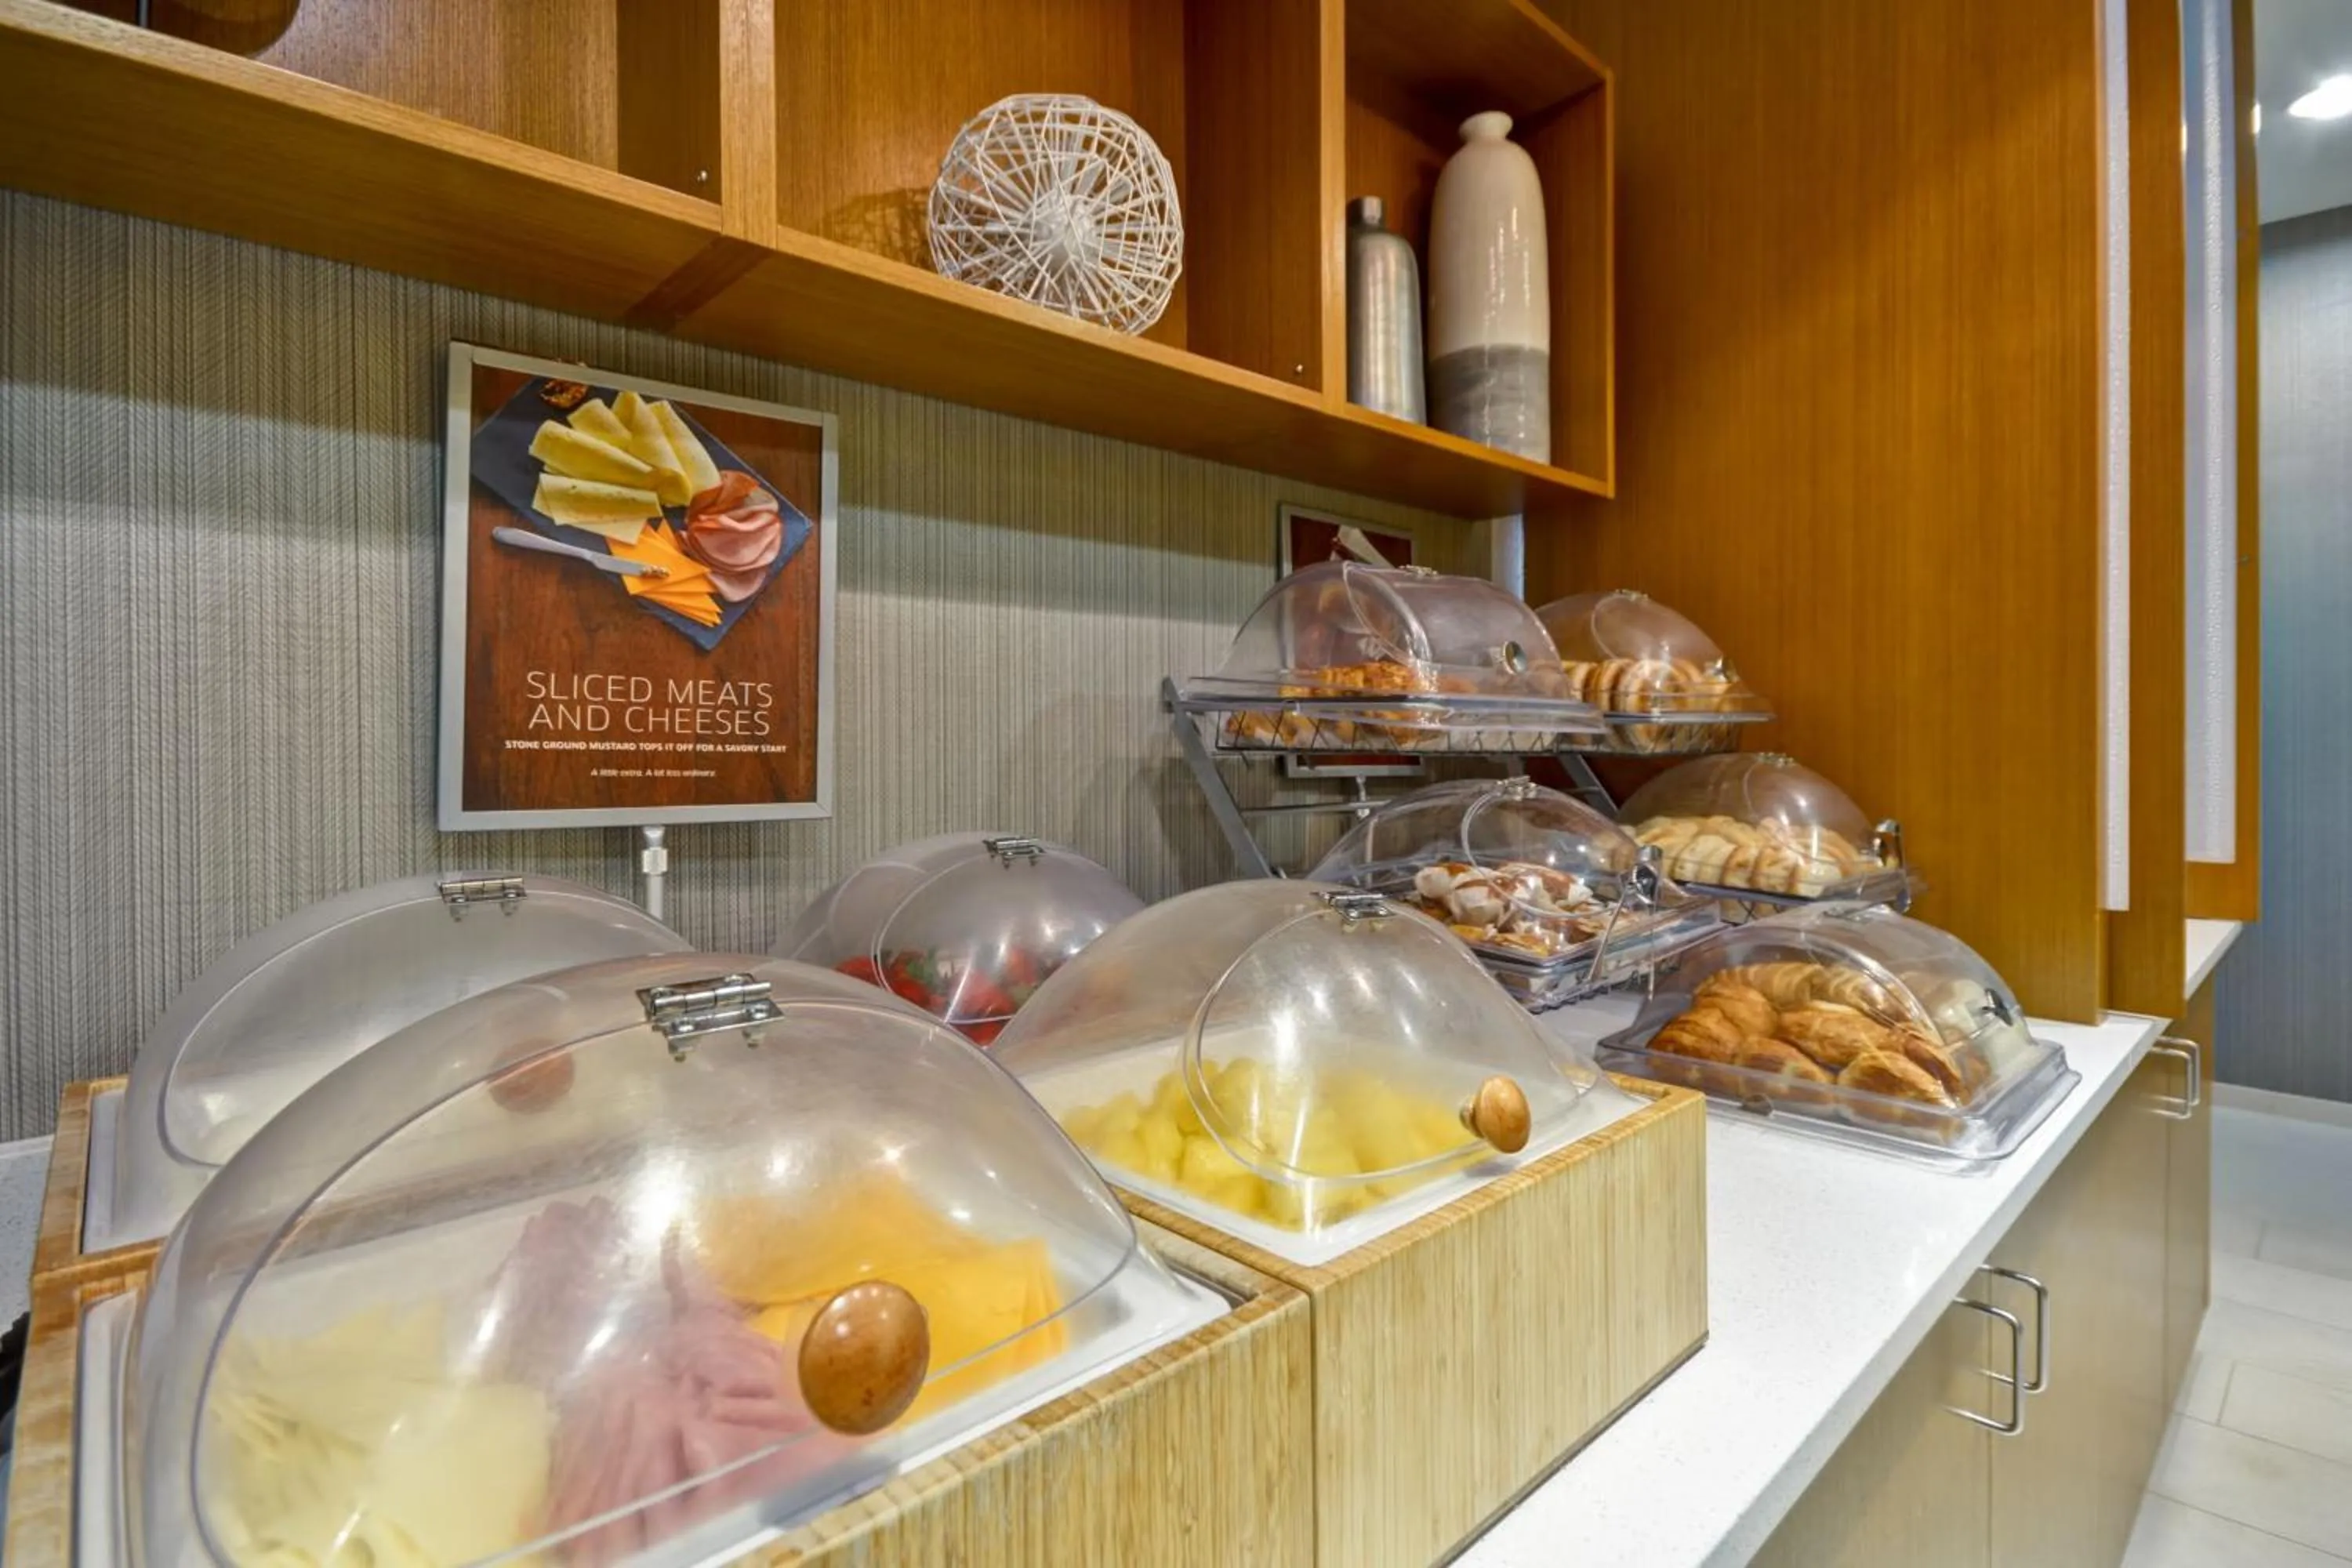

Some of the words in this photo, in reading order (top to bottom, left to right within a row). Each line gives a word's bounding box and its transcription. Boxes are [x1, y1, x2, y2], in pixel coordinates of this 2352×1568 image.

[526, 670, 652, 703] SLICED
[667, 678, 773, 709] MEATS
[528, 703, 610, 731] AND
[625, 706, 771, 736] CHEESES
[504, 740, 540, 750] STONE
[542, 741, 587, 750] GROUND
[589, 742, 637, 750] MUSTARD
[639, 742, 662, 751] TOPS
[665, 742, 674, 751] IT
[676, 743, 694, 752] OFF
[695, 743, 714, 753] FOR
[724, 744, 759, 753] SAVORY
